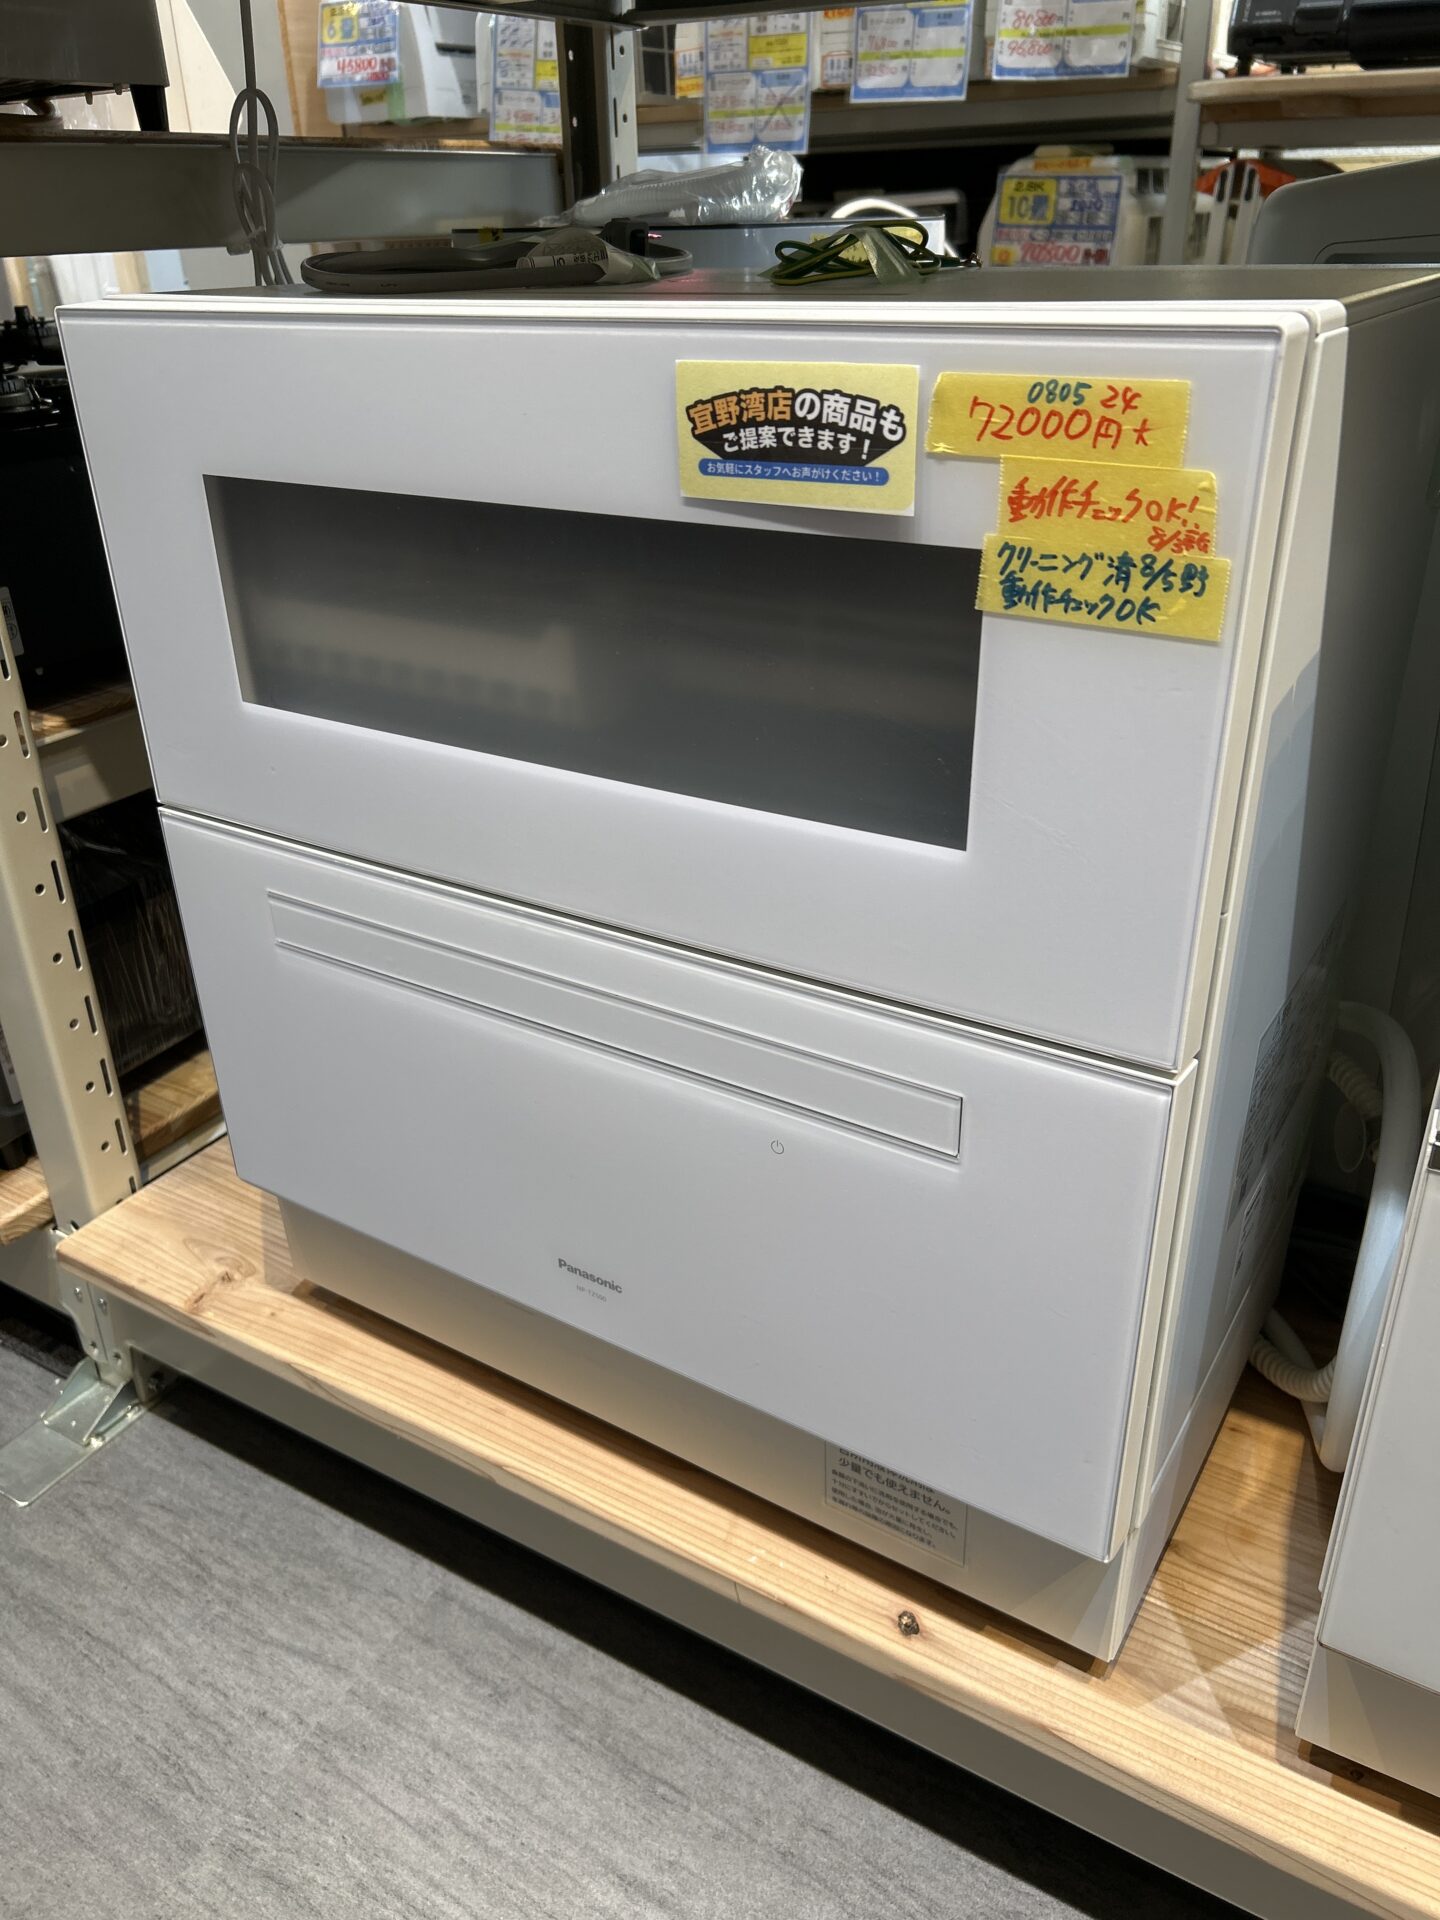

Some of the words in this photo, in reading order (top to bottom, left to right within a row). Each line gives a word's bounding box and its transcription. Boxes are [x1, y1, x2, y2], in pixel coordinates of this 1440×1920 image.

[1027, 378, 1093, 406] 0805
[689, 389, 904, 442] 宜野湾店の商品も
[968, 395, 1123, 450] 72000円
[722, 425, 871, 460] ご提案できます！
[706, 461, 881, 483] お気軽にスタッフへお声がけください！
[557, 1257, 624, 1294] Panasonic
